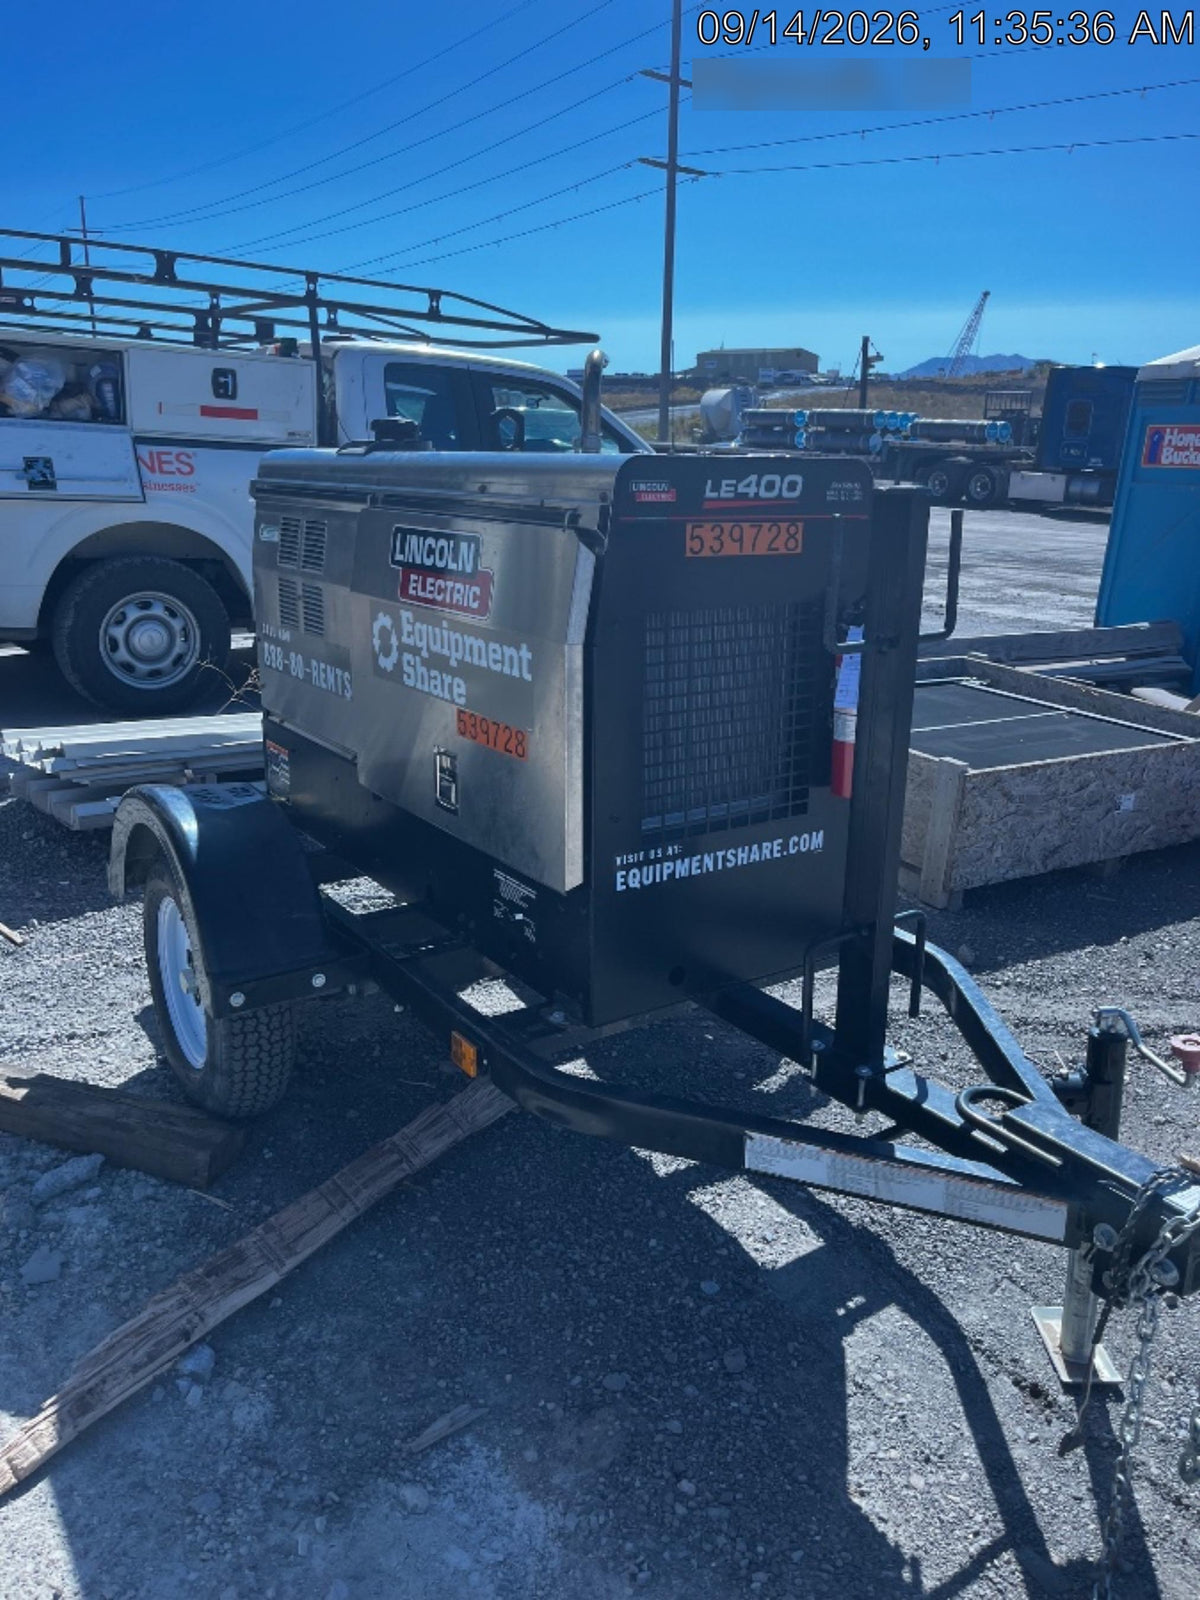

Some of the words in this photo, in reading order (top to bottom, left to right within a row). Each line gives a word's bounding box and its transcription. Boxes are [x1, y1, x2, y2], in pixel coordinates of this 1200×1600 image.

[705, 473, 803, 499] LE400
[393, 532, 476, 574] LINCOLN
[688, 522, 800, 556] 539728
[408, 573, 481, 609] ELECTRIC
[401, 609, 533, 682] Equipment
[402, 651, 467, 706] Share
[456, 709, 526, 758] 539728
[615, 850, 645, 867] VISIT
[649, 847, 663, 860] US
[616, 829, 825, 892] EQUIPMENTSHARE.COM
